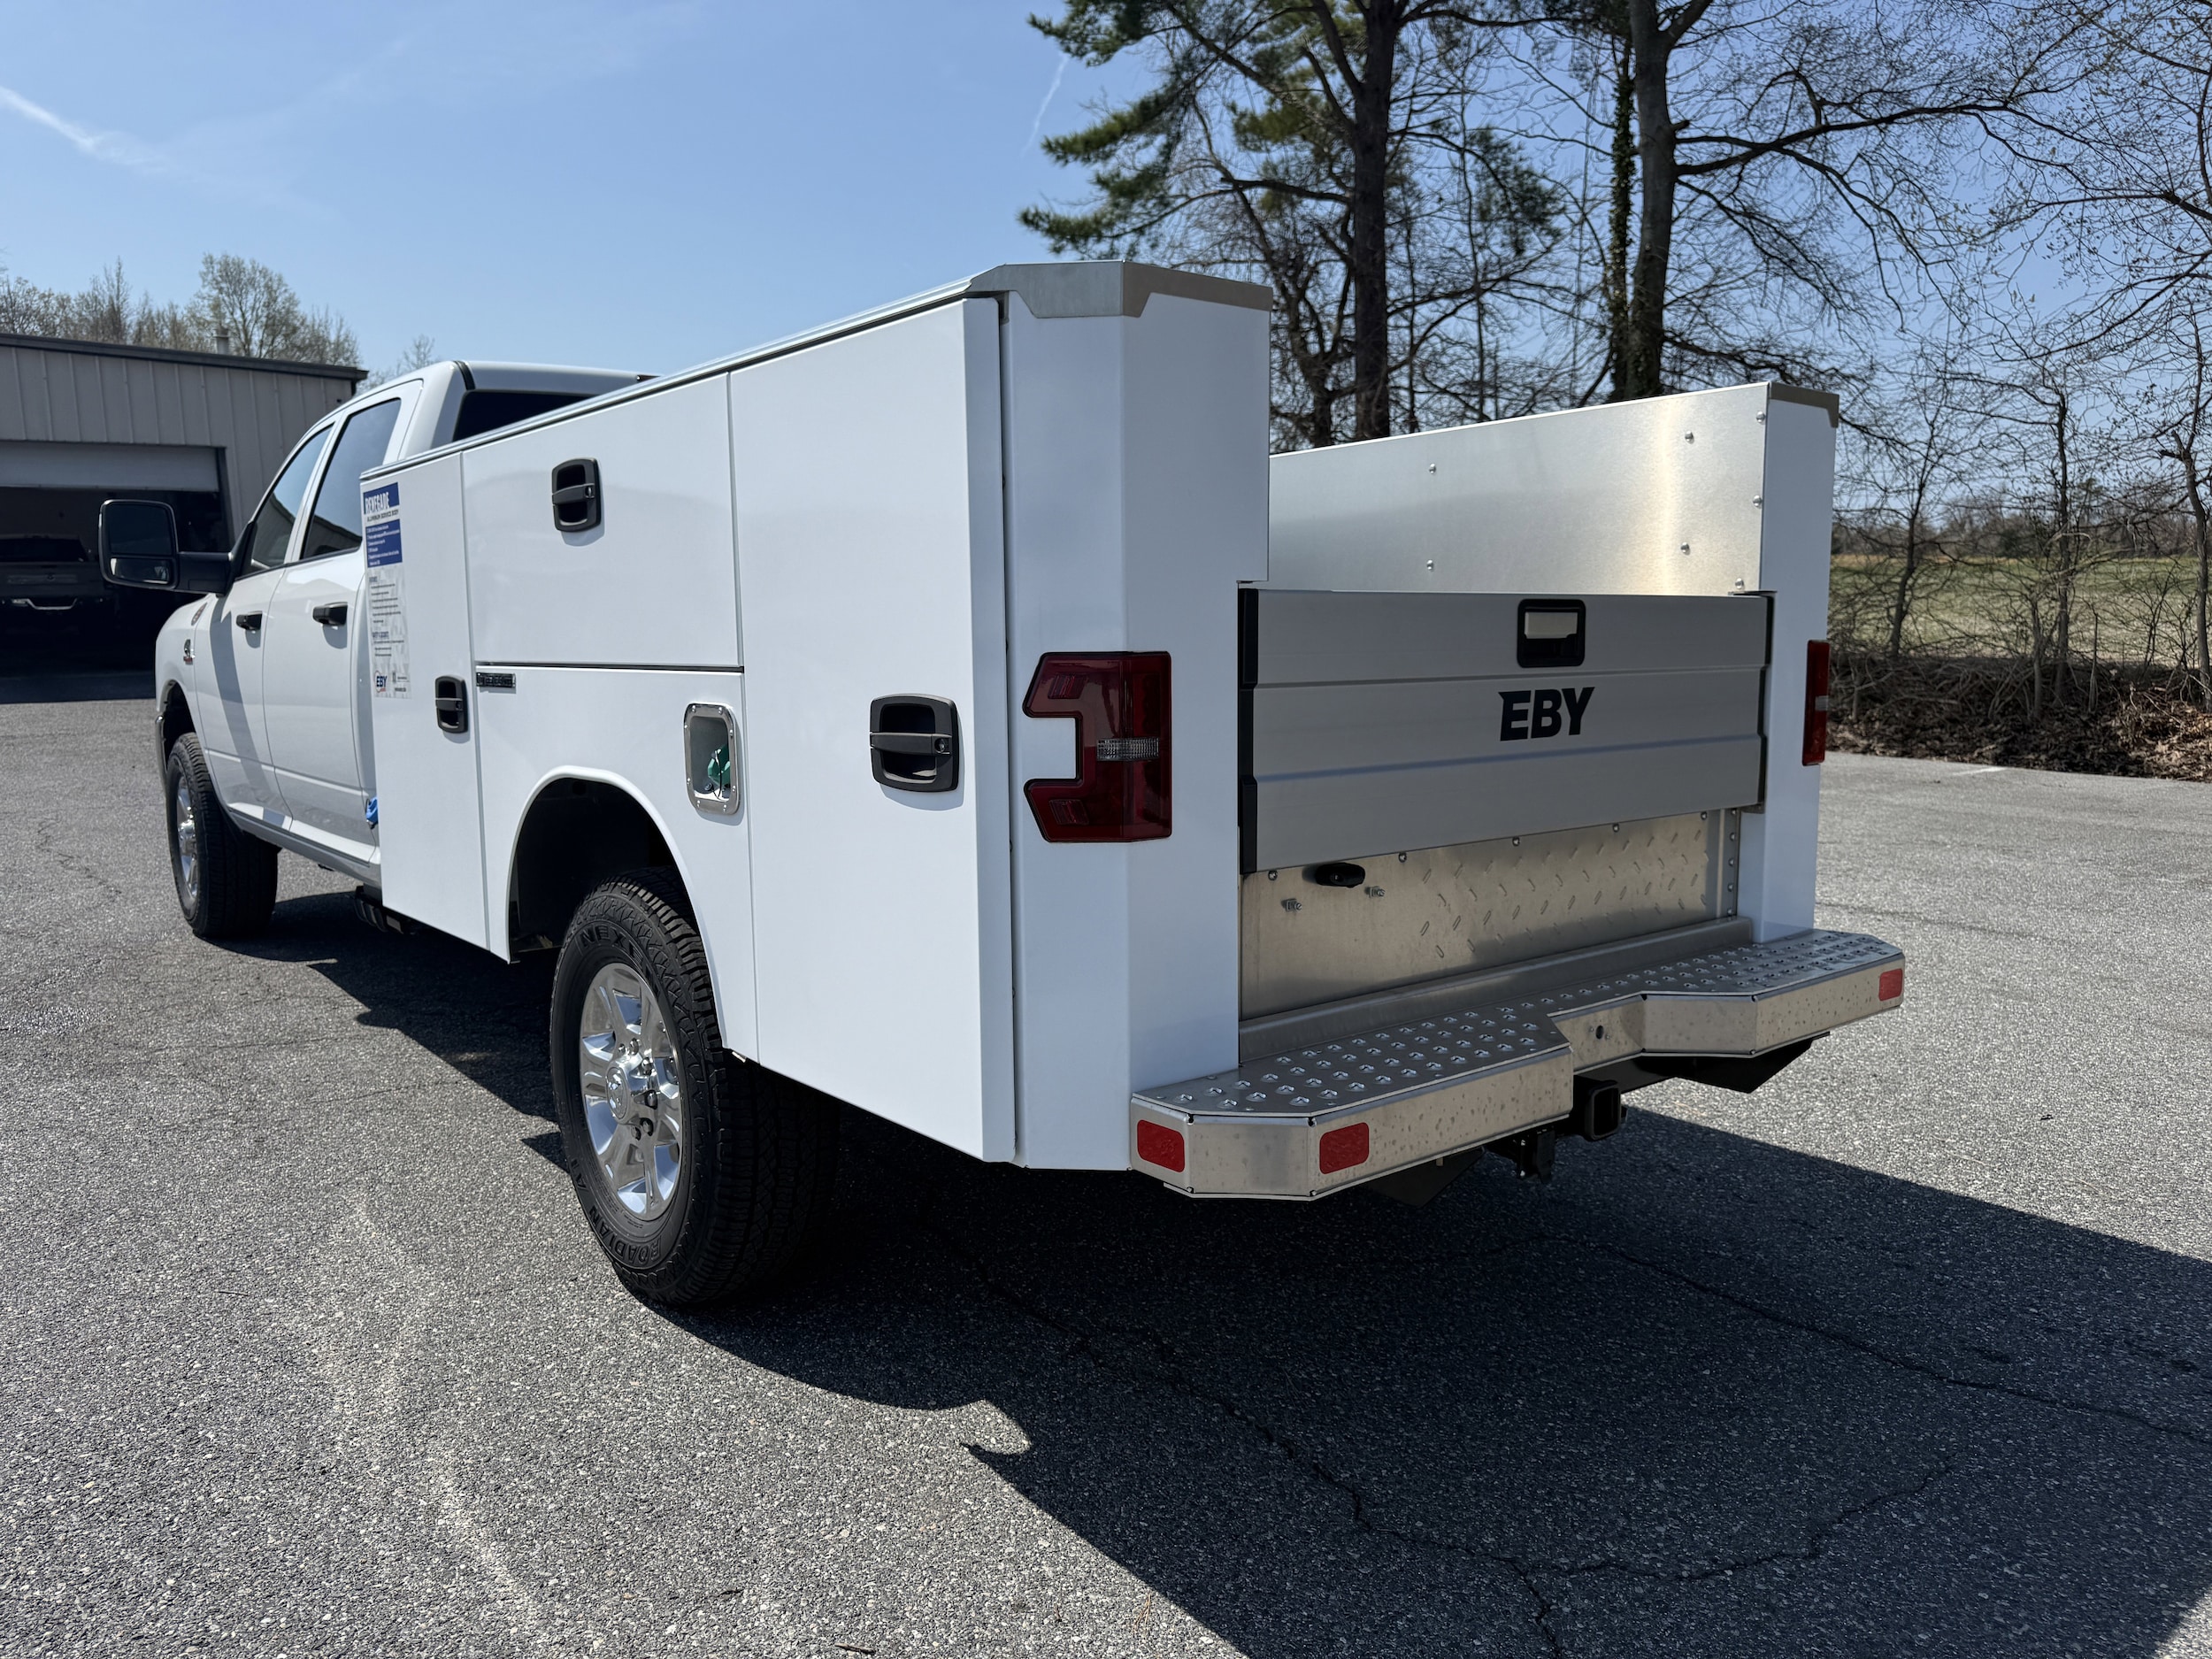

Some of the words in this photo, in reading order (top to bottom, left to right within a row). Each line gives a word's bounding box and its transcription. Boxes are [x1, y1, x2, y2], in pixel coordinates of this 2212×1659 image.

[365, 492, 390, 514] RENEGADE
[376, 676, 388, 687] EBY
[1498, 687, 1595, 741] EBY
[588, 1205, 662, 1264] ROADIAN
